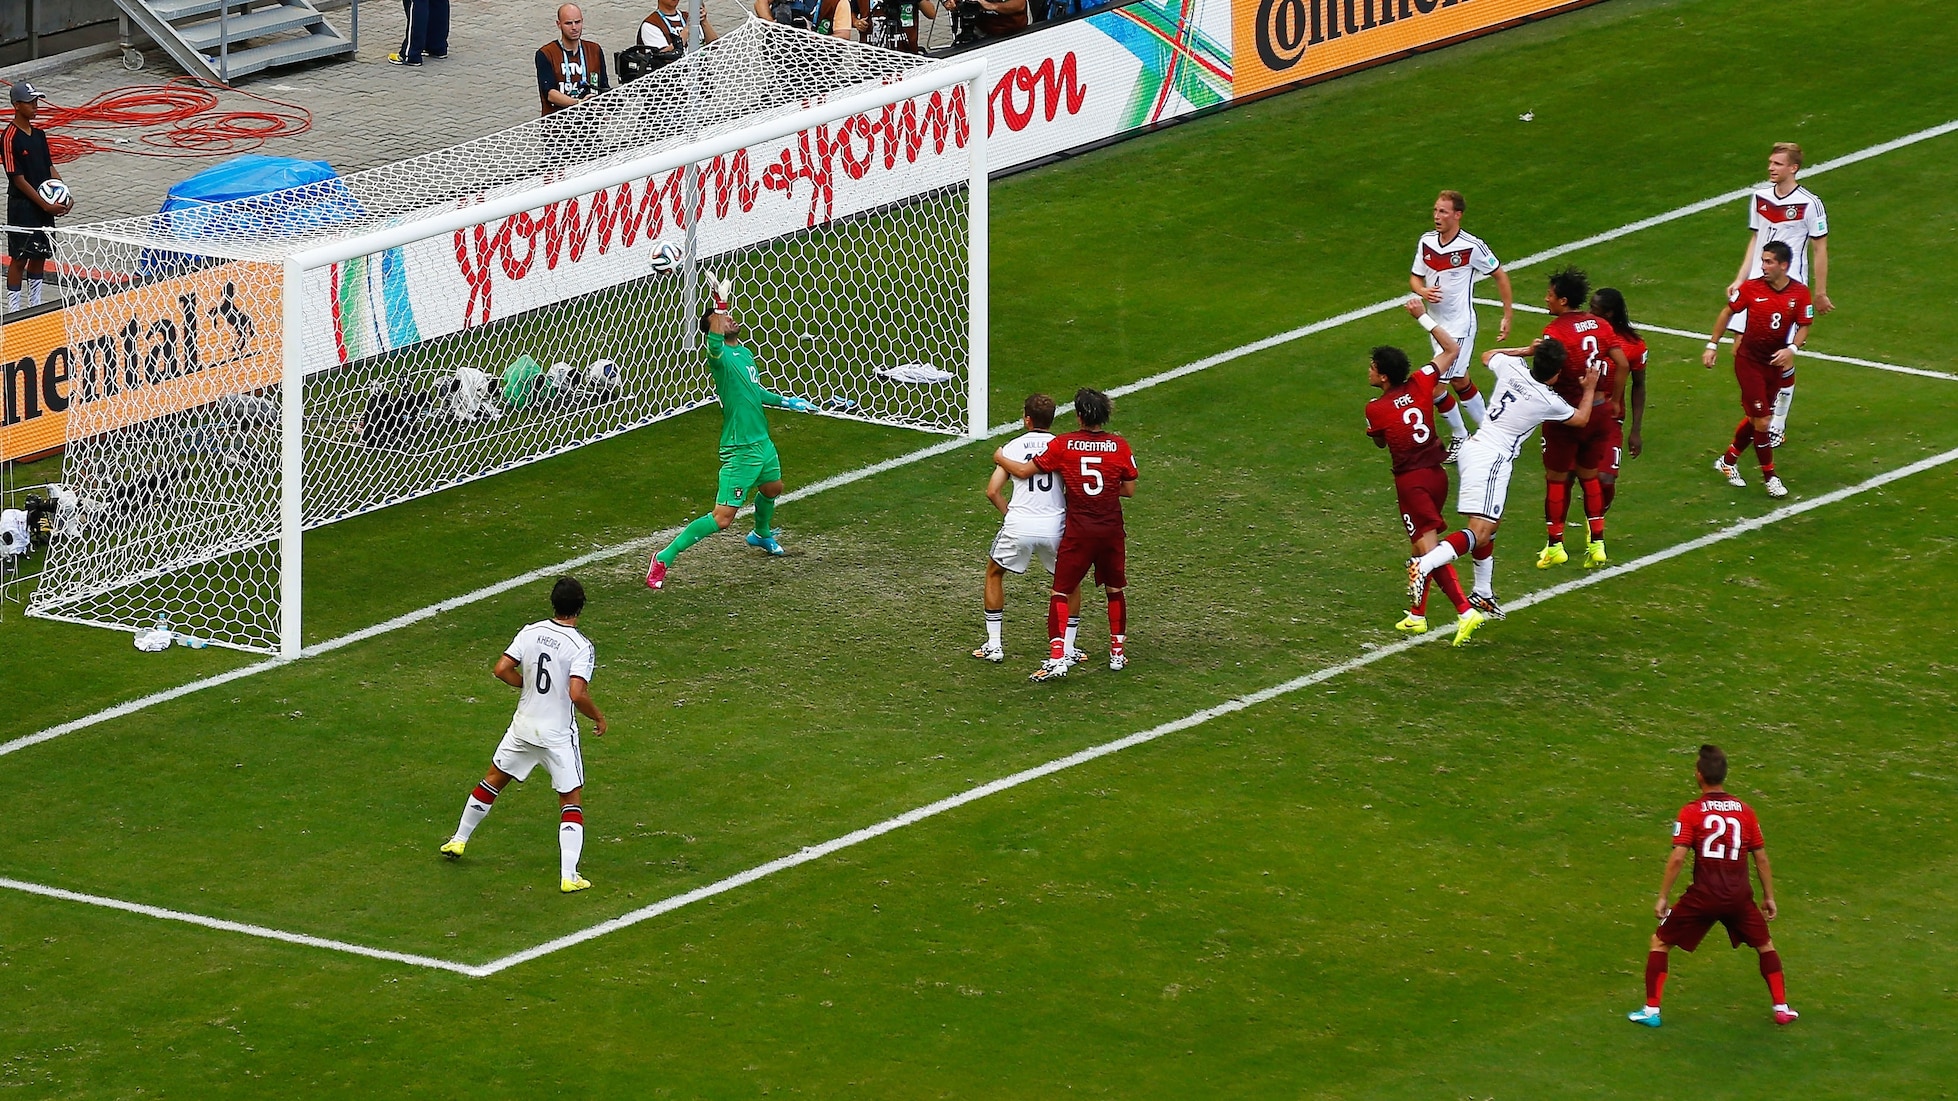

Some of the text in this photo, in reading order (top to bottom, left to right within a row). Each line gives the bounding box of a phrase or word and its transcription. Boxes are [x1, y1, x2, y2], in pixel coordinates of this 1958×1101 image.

[798, 51, 1087, 227] Johnon
[1771, 312, 1782, 330] 8
[1582, 335, 1601, 369] 2
[746, 365, 758, 383] 12
[1393, 393, 1414, 409] PEPE
[1489, 390, 1516, 422] 5
[1402, 406, 1431, 444] 3
[1080, 456, 1104, 496] 5
[1403, 513, 1415, 531] 3
[536, 652, 552, 694] 6
[1703, 814, 1742, 861] 21
